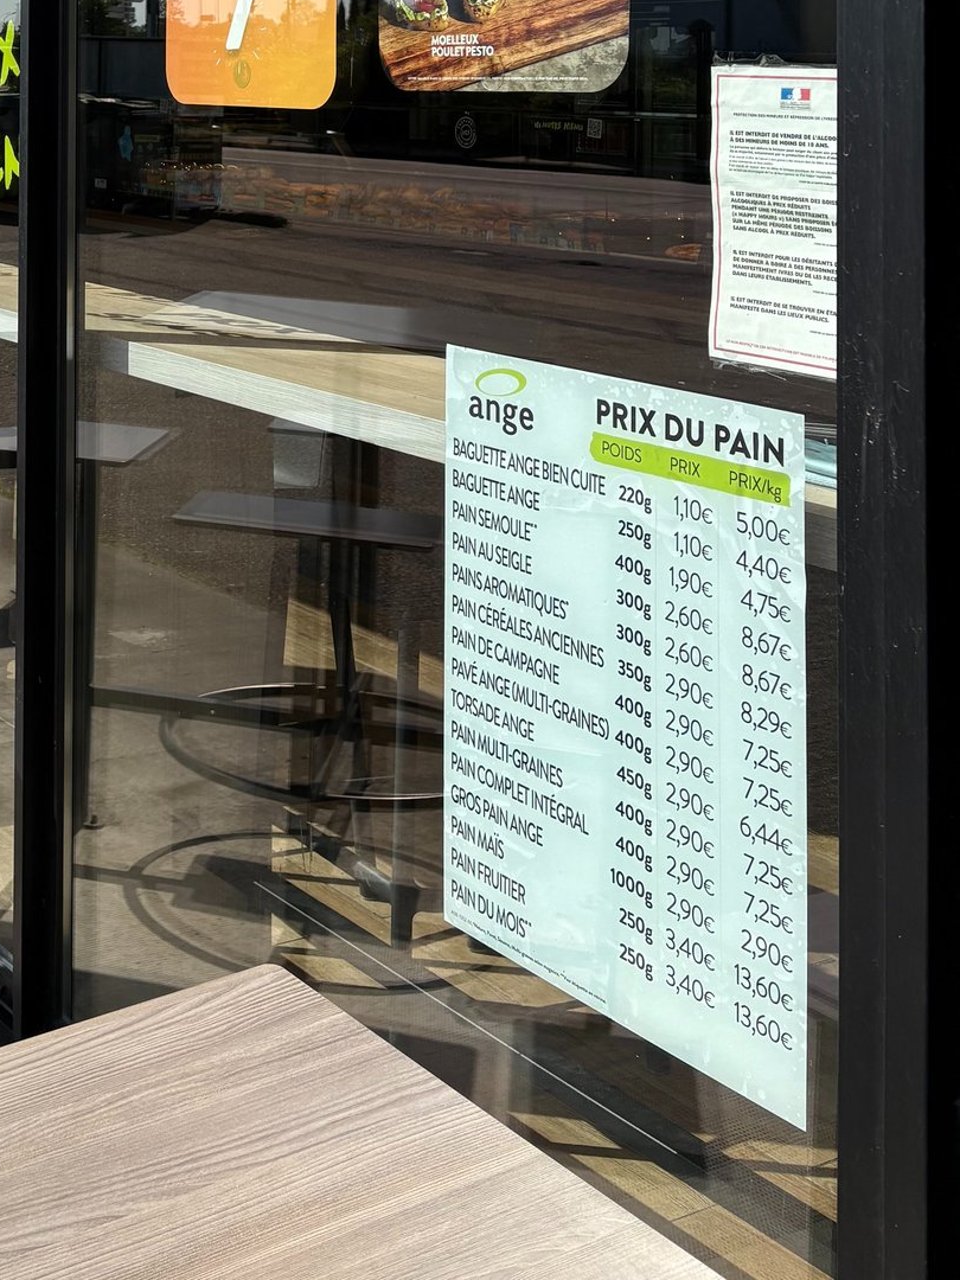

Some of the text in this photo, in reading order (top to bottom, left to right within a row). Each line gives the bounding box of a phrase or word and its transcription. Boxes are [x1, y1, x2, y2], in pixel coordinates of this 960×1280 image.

[431, 34, 479, 46] MOELLEUX
[431, 45, 494, 58] POULET PESTO
[468, 395, 534, 435] ange
[596, 399, 784, 468] PRIX DU PAIN
[452, 468, 540, 512] BAGUETTE ANGE
[453, 437, 606, 496] BAGUETTE ANGE BIEN CUITE
[602, 440, 782, 504] POIDS PRIX PRIX/kg
[452, 500, 477, 525] PAIN
[618, 484, 790, 546] 220g 1,10€ 5,00€
[452, 531, 532, 575] PAIN AU SEIGLE
[452, 562, 483, 590] PAINS
[618, 519, 792, 584] 250g 1,10€ 4,40€
[614, 554, 791, 623] 400g 1,90€ 4,75€
[452, 594, 604, 668] PAIN CÉRÉALES ANCIENNES
[452, 625, 560, 686] PAIN DE CAMPAGNE
[616, 588, 792, 662] 300g 2,60€ 8,67€
[616, 623, 792, 700] 300g 2,60€ 8,67€
[450, 688, 535, 742] TORSADE ANGE
[452, 657, 610, 740] PAVÉ ANGE (MULTI-GRAINES)
[618, 659, 792, 740] 350g 2,90€ 8,29€
[451, 720, 564, 788] PAIN MULTI-GRAINES
[614, 694, 792, 778] 400g 2,90€ 7,25€
[451, 751, 590, 836] PAIN COMPLET INTÉGRAL
[614, 730, 792, 818] 400g 2,90€ 7,25€
[450, 784, 544, 847] GROS PAIN ANGE
[451, 815, 504, 860] PAIN MAÏS
[616, 766, 792, 856] 450g 2,90€ 6,44€
[451, 846, 526, 905] PAIN FRUITIER
[615, 800, 792, 896] 400g 2,90€ 7,25€
[451, 879, 476, 910] PAIN
[478, 894, 494, 920] DU
[615, 836, 792, 934] 400g 2,90€ 7,25€
[610, 867, 792, 973] 1000g 2,90€ 2,90€
[619, 907, 792, 1012] 250g 3,40€ 13,60€
[619, 943, 792, 1051] 250g 3,40€ 13,60€
